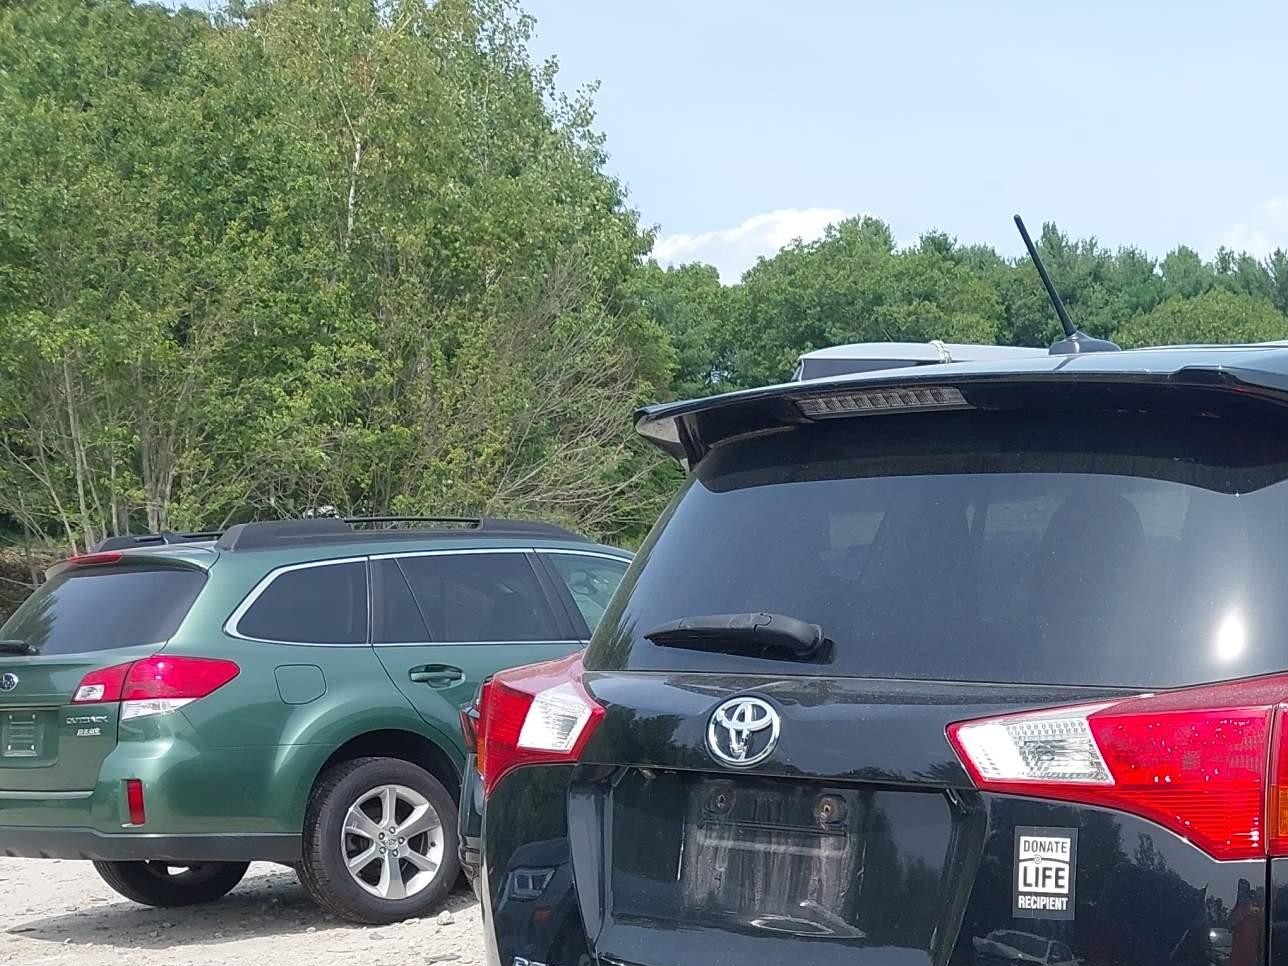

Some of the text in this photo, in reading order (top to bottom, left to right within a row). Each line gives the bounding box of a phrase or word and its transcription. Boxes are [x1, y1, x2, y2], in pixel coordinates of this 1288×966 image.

[1023, 840, 1067, 853] DONATE
[1023, 866, 1065, 888] LIFE
[1018, 895, 1068, 910] RECIPIENT
